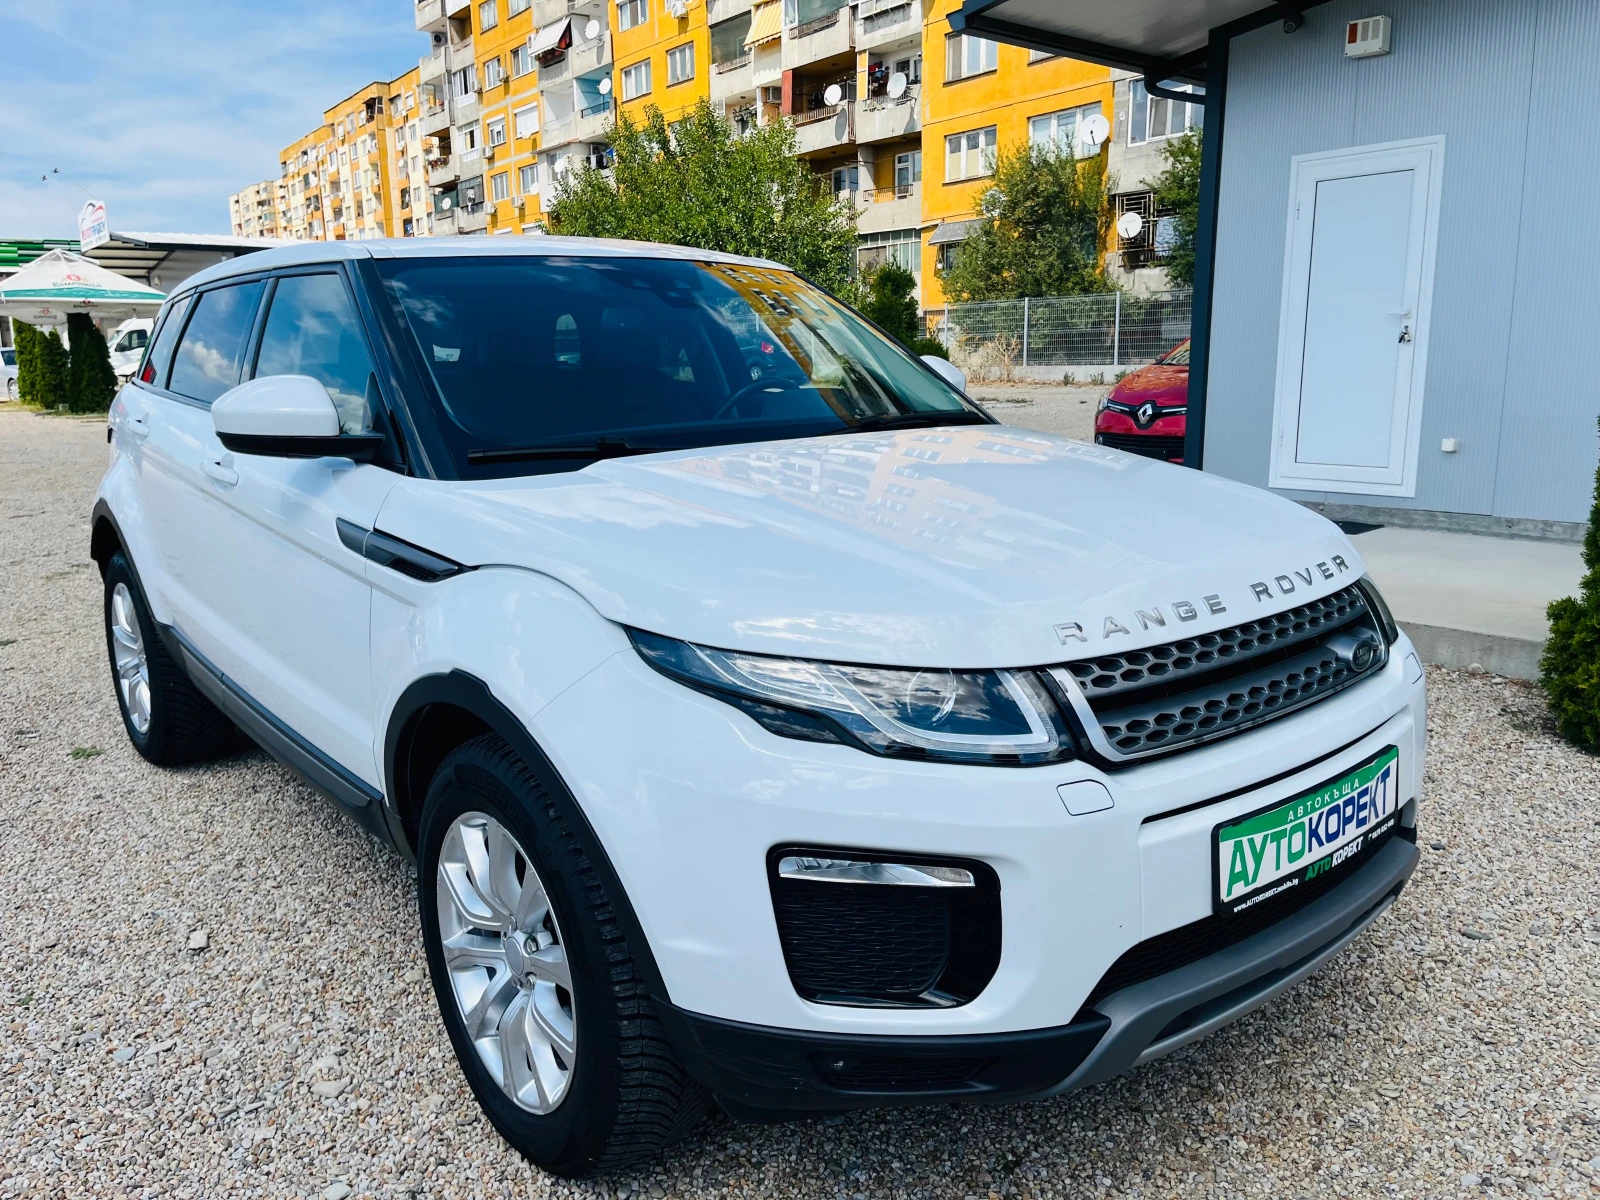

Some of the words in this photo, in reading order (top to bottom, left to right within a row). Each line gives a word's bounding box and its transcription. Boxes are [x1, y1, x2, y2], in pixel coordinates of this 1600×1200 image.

[1053, 593, 1228, 646] RANGE
[1248, 554, 1351, 603] ROVER
[1226, 765, 1391, 898] АУТОКОРЕКТ
[1287, 778, 1360, 822] АВТОКЪЩА
